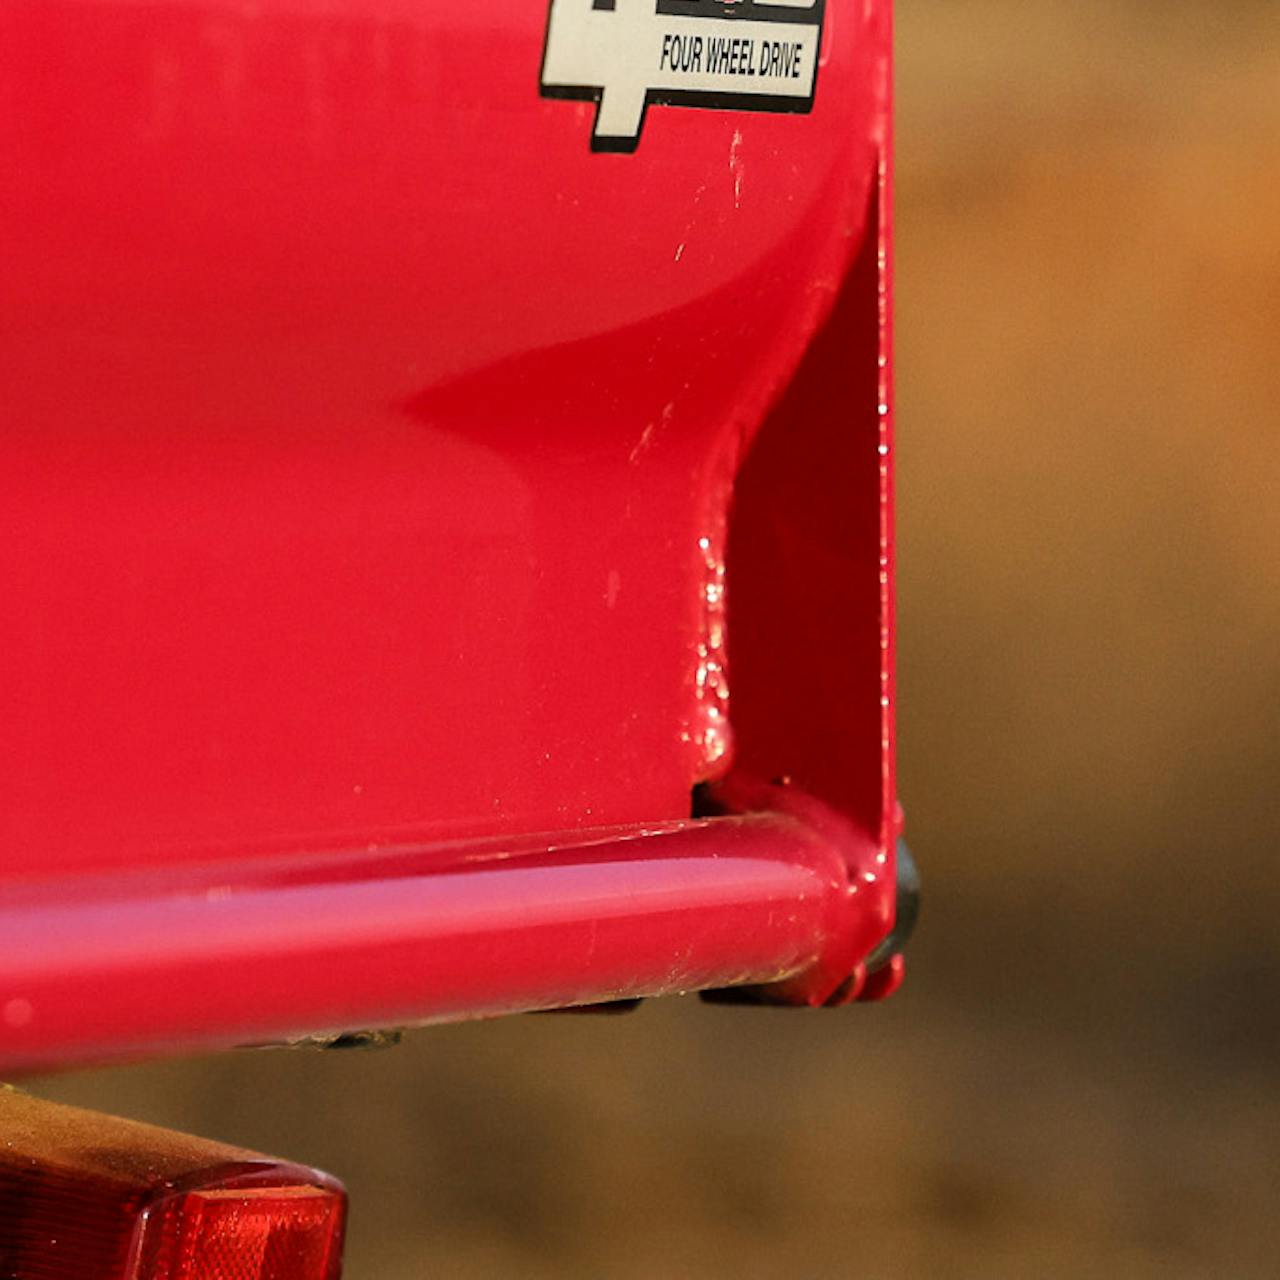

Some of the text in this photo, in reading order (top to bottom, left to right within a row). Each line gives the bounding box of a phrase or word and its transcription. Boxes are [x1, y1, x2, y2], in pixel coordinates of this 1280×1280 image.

[660, 34, 803, 78] FOUR WHEEL DRIVE
